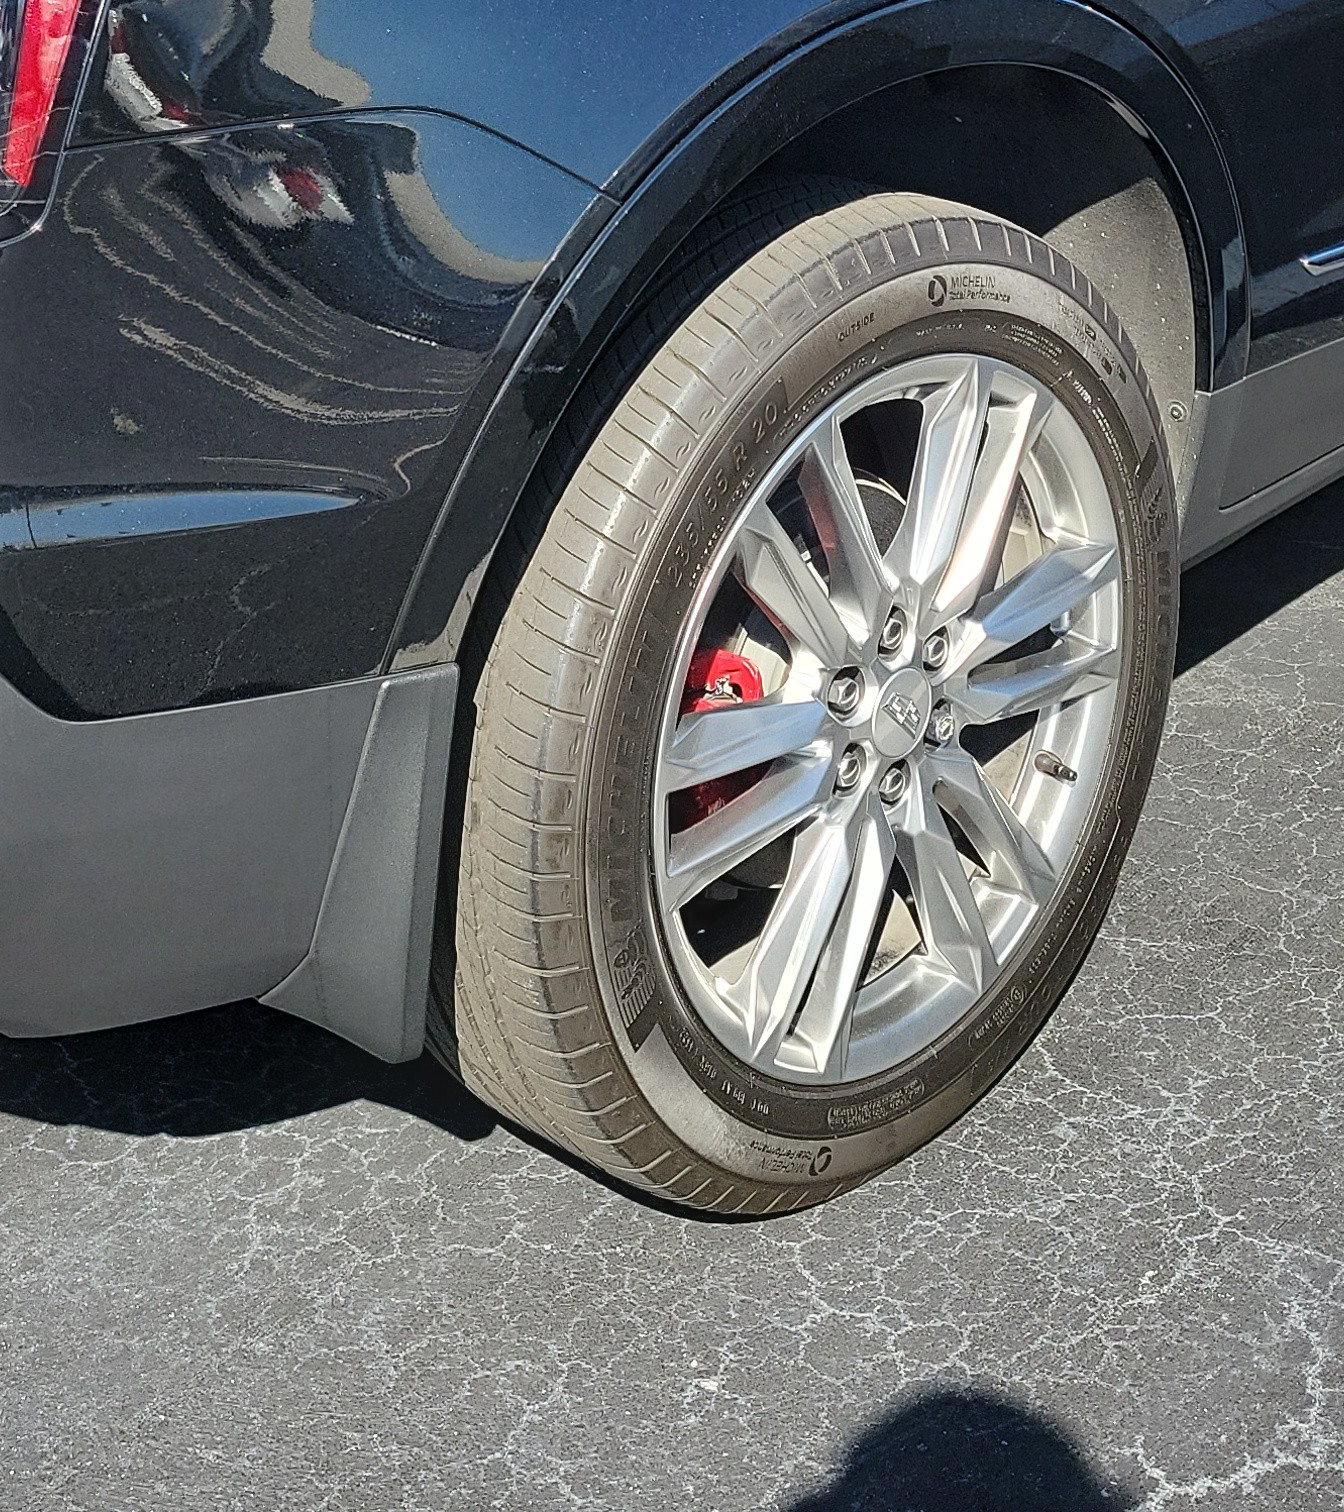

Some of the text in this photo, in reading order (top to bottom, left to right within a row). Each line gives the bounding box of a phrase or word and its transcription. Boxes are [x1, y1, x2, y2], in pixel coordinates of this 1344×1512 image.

[950, 274, 996, 290] MICHELIN
[838, 312, 875, 342] OUTSIDE
[752, 400, 779, 445] 20
